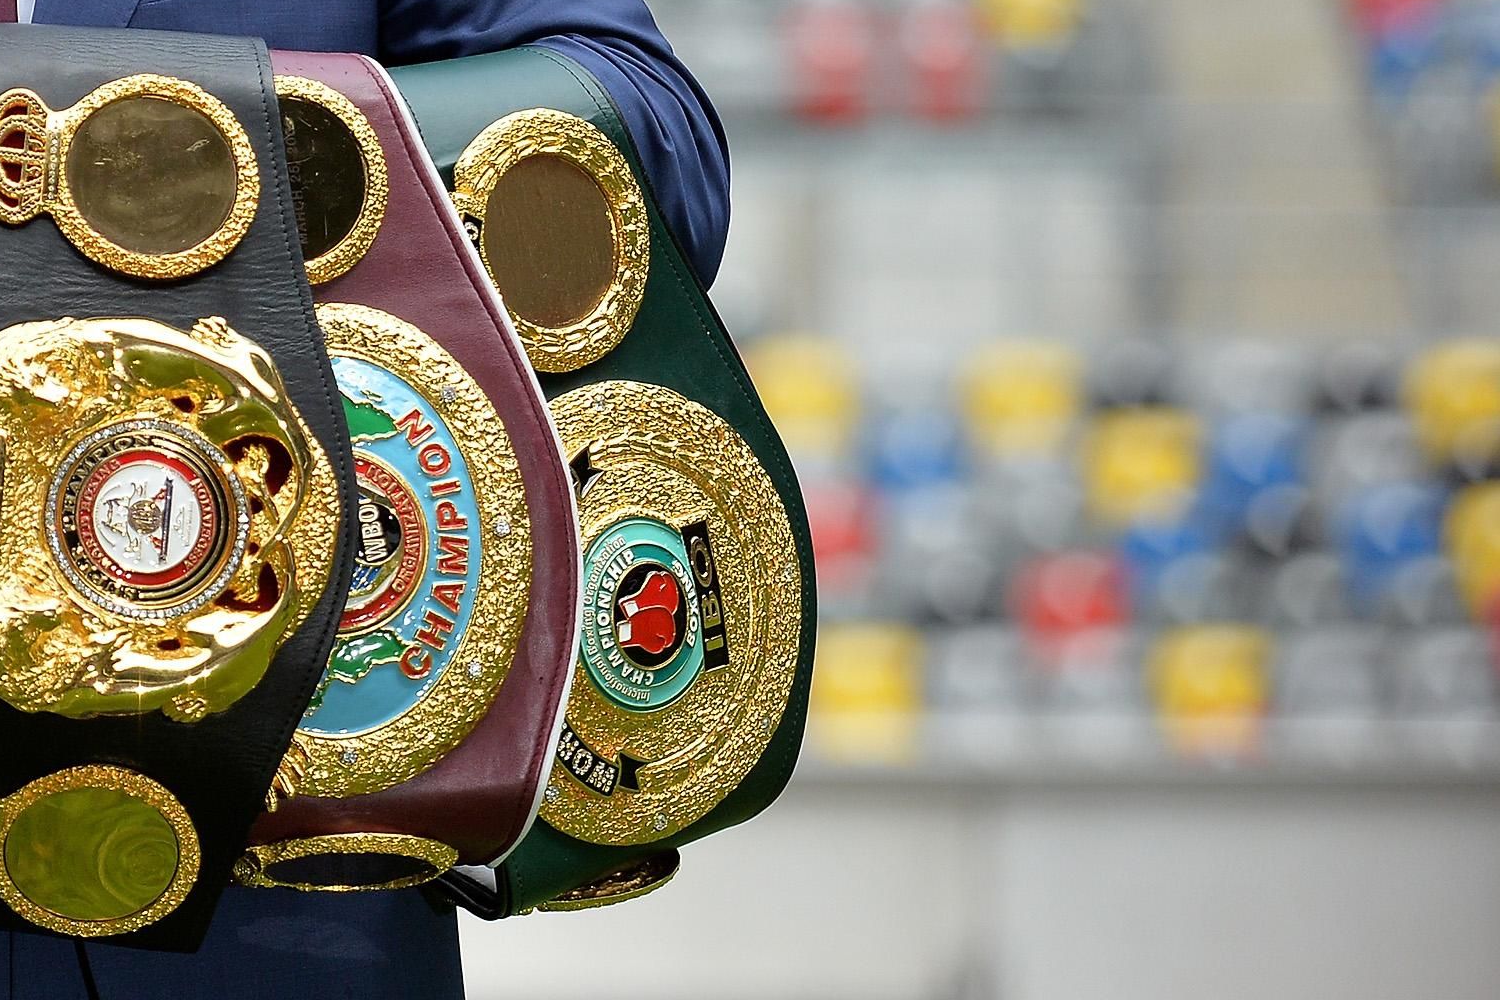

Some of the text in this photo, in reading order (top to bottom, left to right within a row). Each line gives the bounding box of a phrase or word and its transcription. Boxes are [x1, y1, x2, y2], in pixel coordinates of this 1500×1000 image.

[184, 477, 213, 571] ASSOCIATION
[358, 503, 388, 563] WBO
[365, 464, 420, 593] ORGANIZATION
[396, 406, 472, 680] CHAMPION
[582, 535, 651, 703] International Boxing Organization
[596, 548, 655, 686] CHAMPIONSHIP
[671, 559, 699, 648] BOXING
[690, 535, 724, 651] IBO
